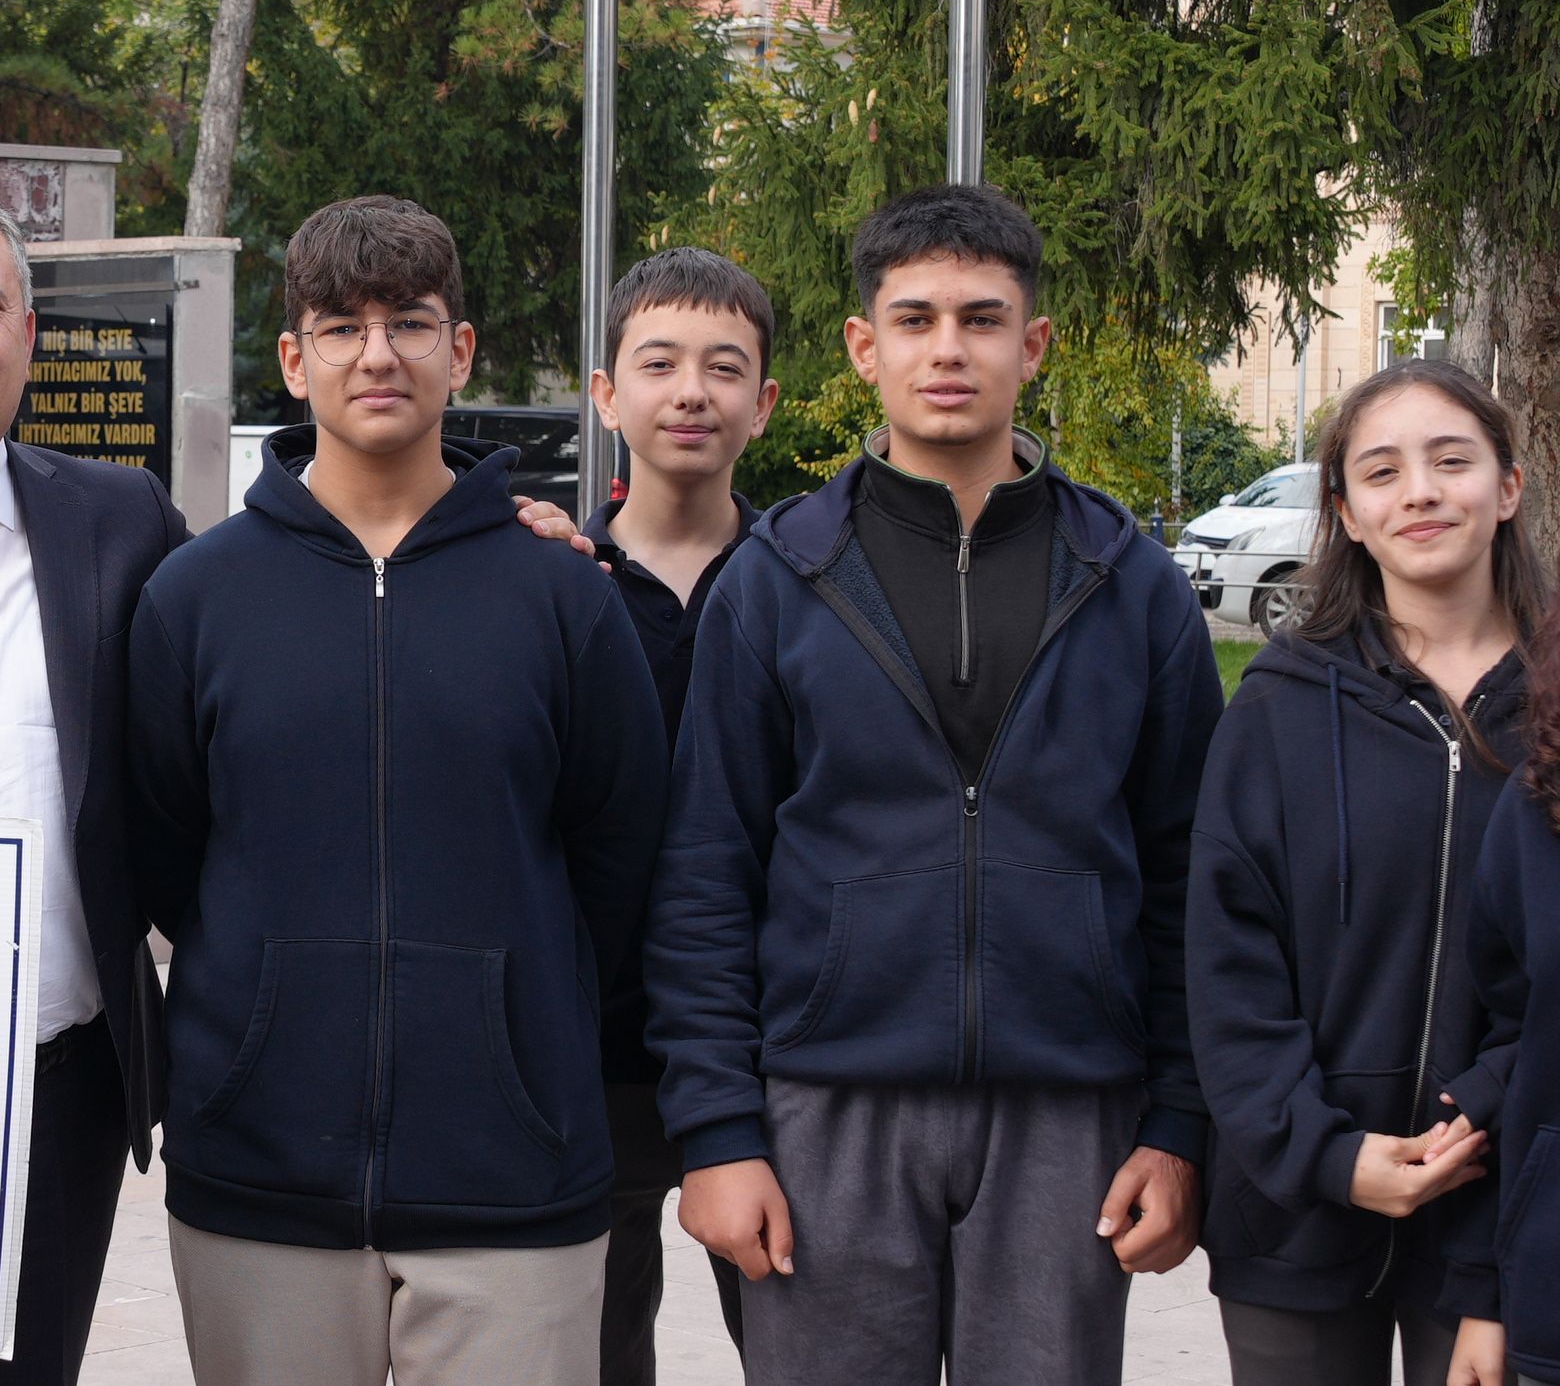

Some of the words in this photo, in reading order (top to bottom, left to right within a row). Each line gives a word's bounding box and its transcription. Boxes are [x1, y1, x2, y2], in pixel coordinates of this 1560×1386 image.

[42, 326, 66, 356] HİÇ
[70, 325, 94, 351] BİR
[97, 329, 133, 356] ŞEYE
[31, 357, 111, 382] HTİYACIMIZ
[115, 360, 147, 385] YOK,
[30, 393, 77, 413] YALNIZ
[81, 388, 105, 413] BİR
[108, 392, 144, 419] ŞEYE
[18, 419, 100, 444] İHTİYACIMIZ
[104, 424, 155, 445] VARDIR
